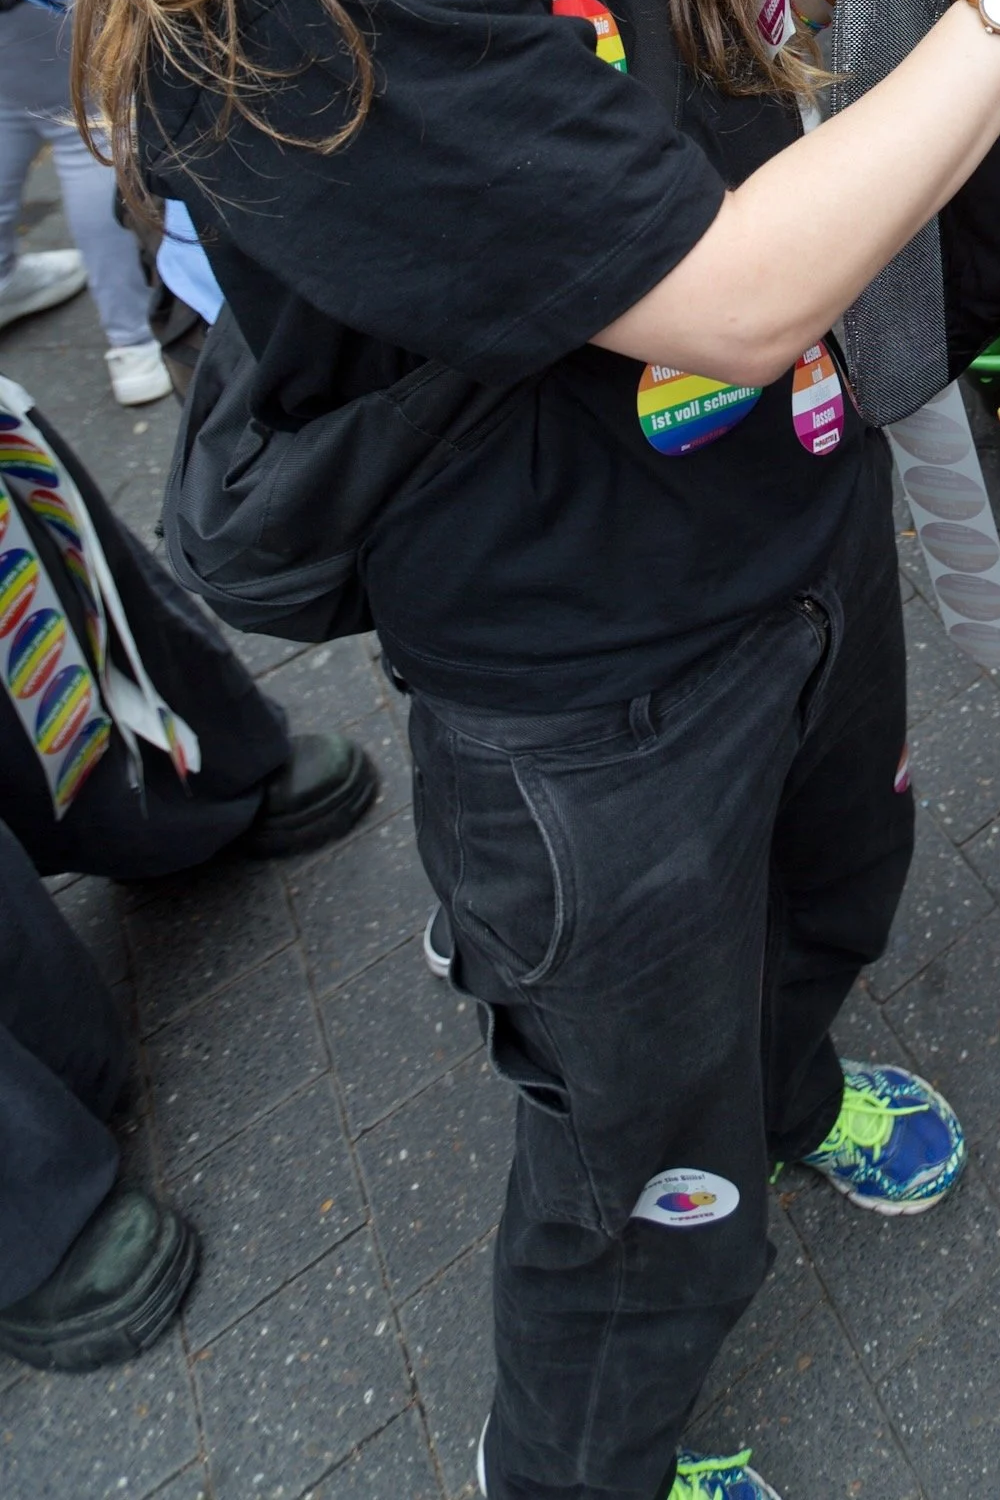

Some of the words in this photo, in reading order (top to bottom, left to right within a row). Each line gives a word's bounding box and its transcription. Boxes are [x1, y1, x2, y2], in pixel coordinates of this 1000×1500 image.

[650, 410, 673, 431] ist
[674, 400, 700, 422] voll
[812, 406, 836, 430] lassen
